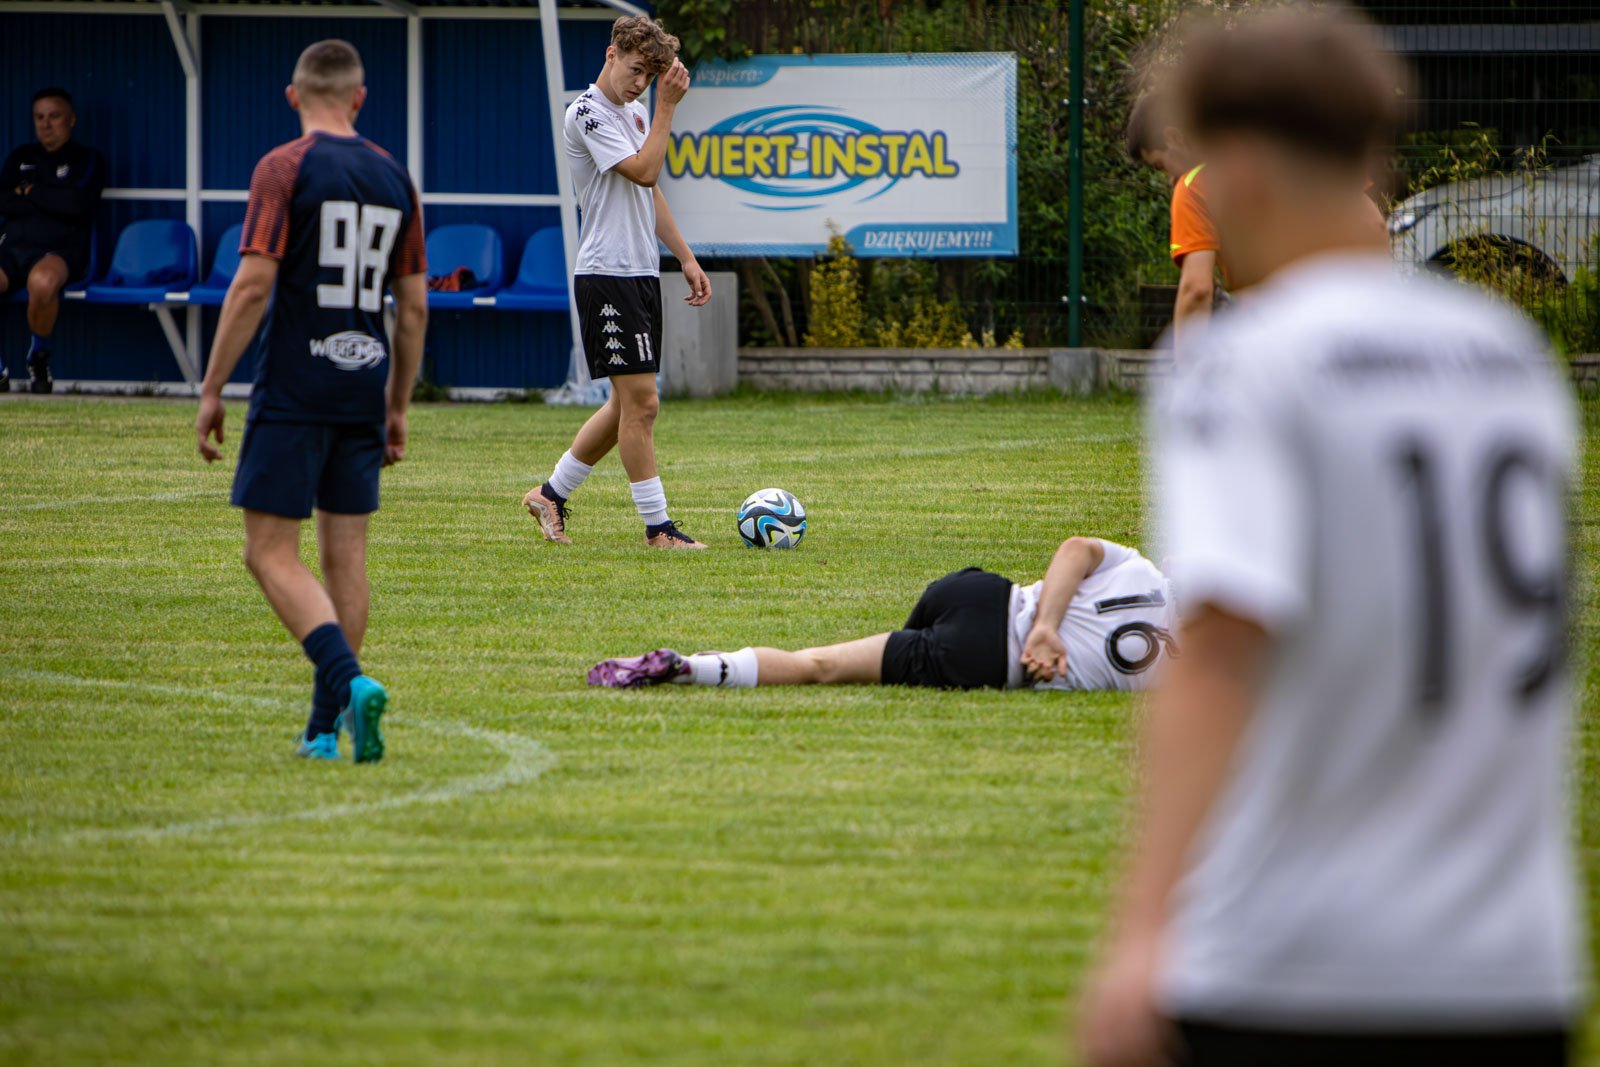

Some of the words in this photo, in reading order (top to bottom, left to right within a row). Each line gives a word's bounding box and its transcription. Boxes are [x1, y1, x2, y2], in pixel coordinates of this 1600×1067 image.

[666, 131, 959, 178] WIERT-INSTAL
[316, 200, 403, 313] 98
[864, 230, 993, 254] DZIĘKUJEMY!!!
[634, 332, 653, 362] 11
[1385, 426, 1567, 714] 19
